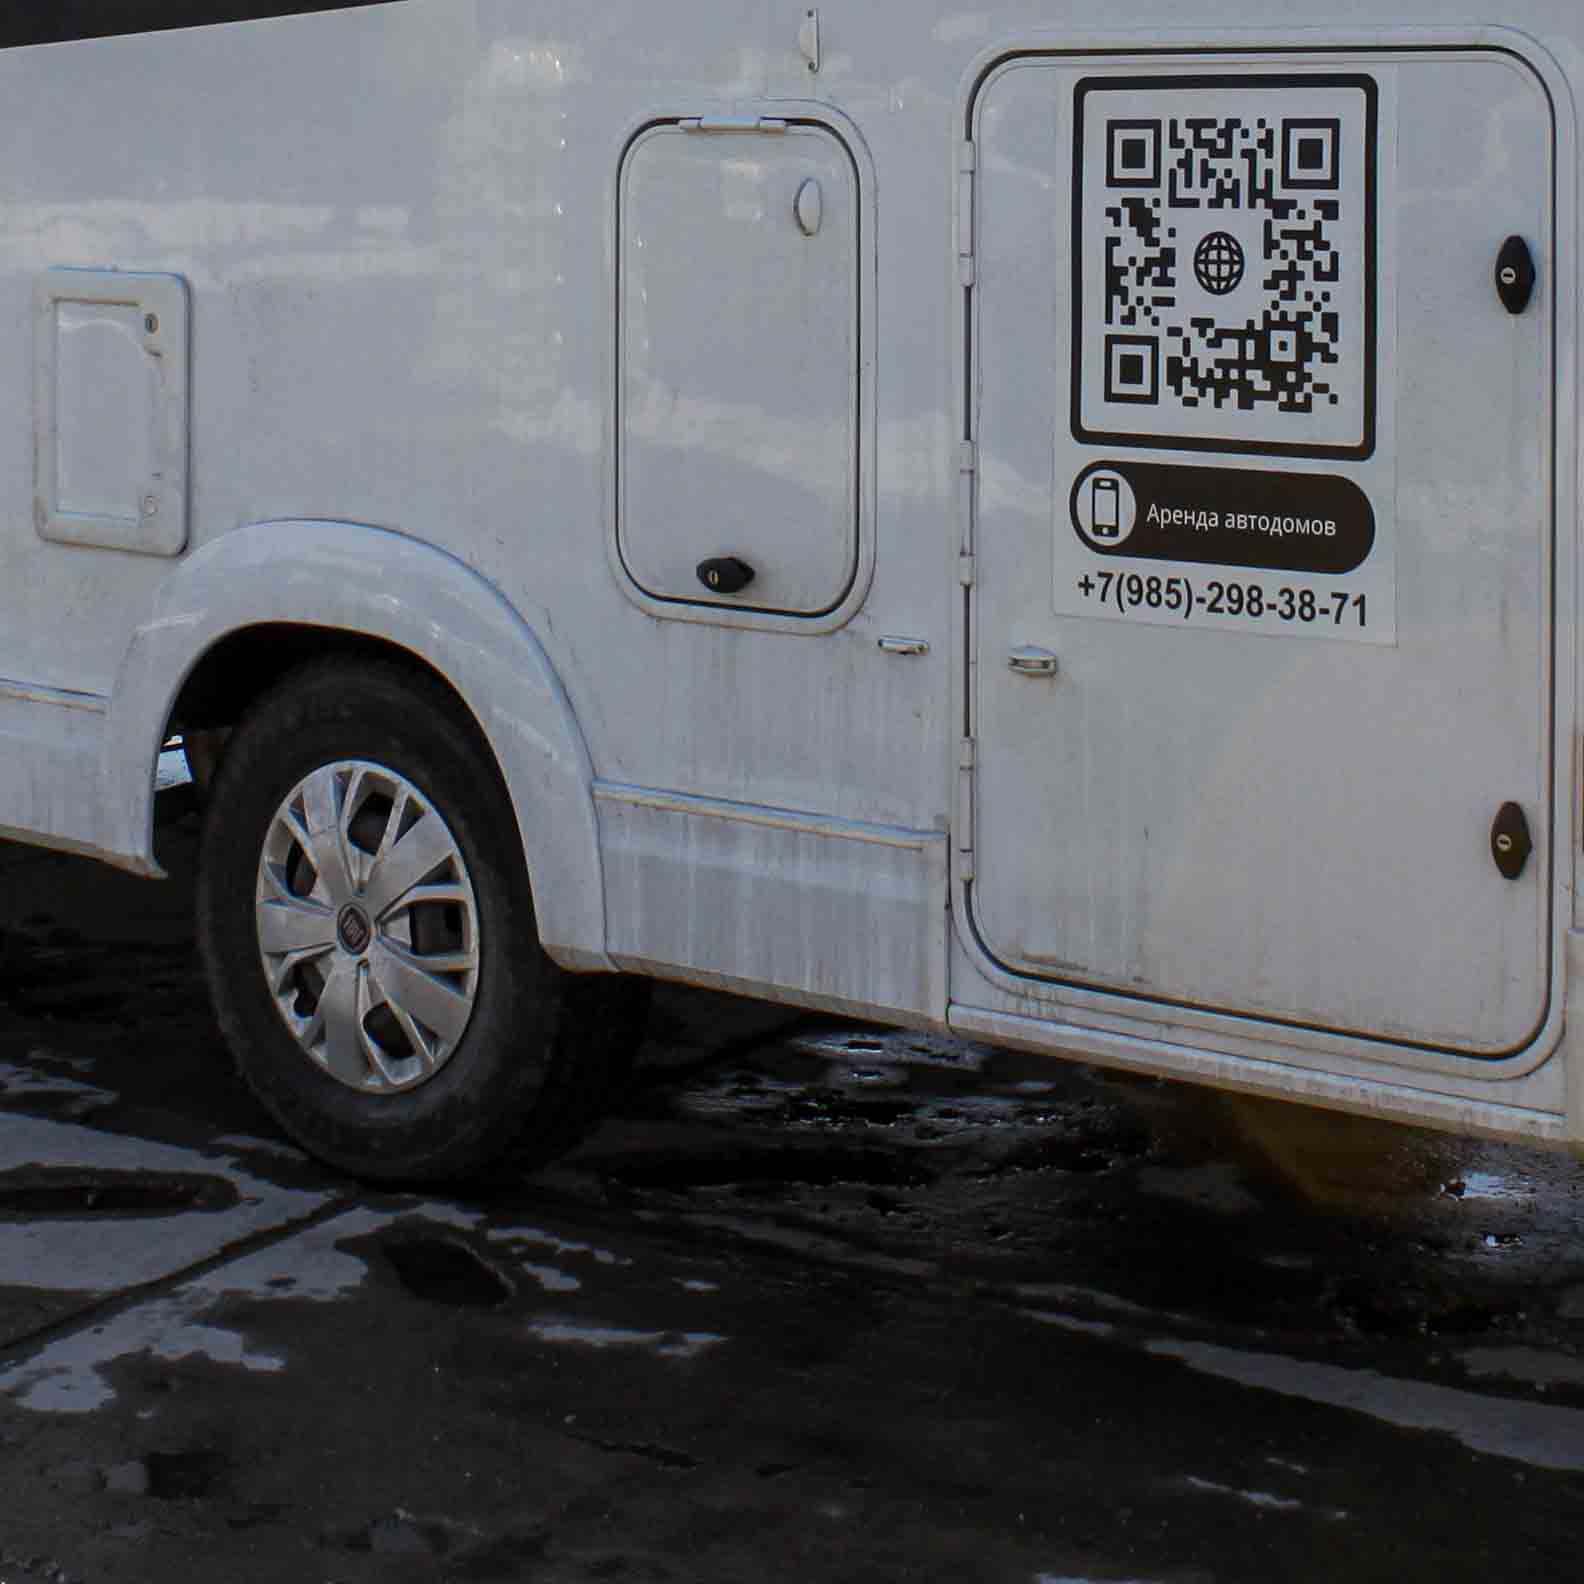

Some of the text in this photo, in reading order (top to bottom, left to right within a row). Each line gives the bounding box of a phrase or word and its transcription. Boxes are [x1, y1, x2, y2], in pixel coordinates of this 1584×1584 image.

[1146, 503, 1337, 537] Аренда автодомов
[1077, 571, 1367, 627] +7(985)-298-38-71
